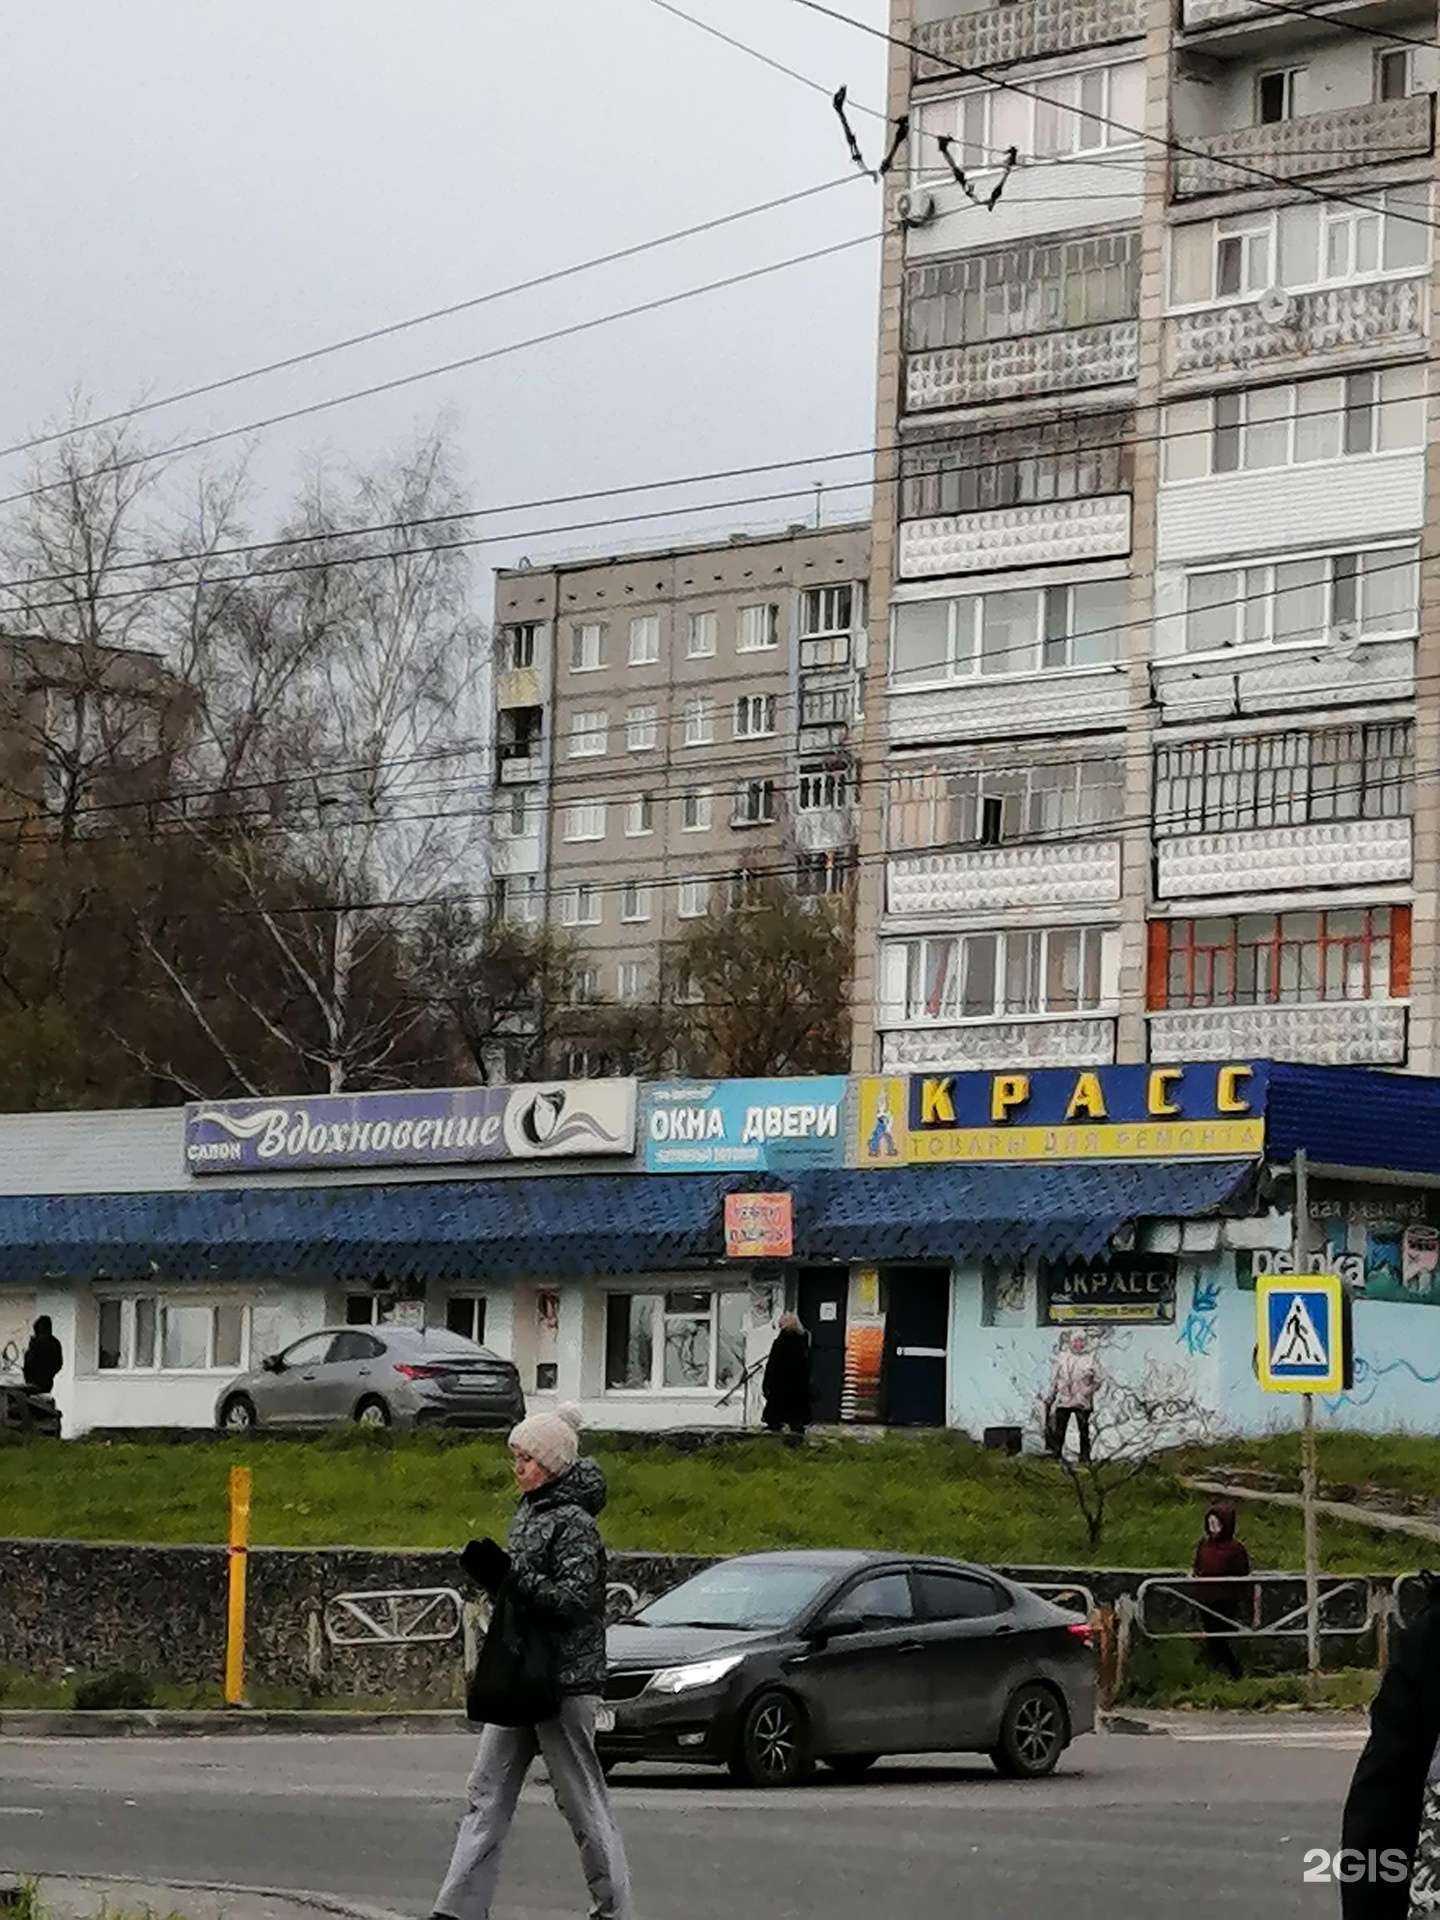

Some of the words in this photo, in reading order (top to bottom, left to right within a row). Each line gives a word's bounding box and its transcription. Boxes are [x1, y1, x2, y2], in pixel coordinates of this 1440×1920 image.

[920, 1065, 1254, 1124] КРАСС
[256, 1109, 501, 1159] Вдохновение
[650, 1106, 725, 1141] ОКНА
[742, 1104, 838, 1143] ДВЕРИ
